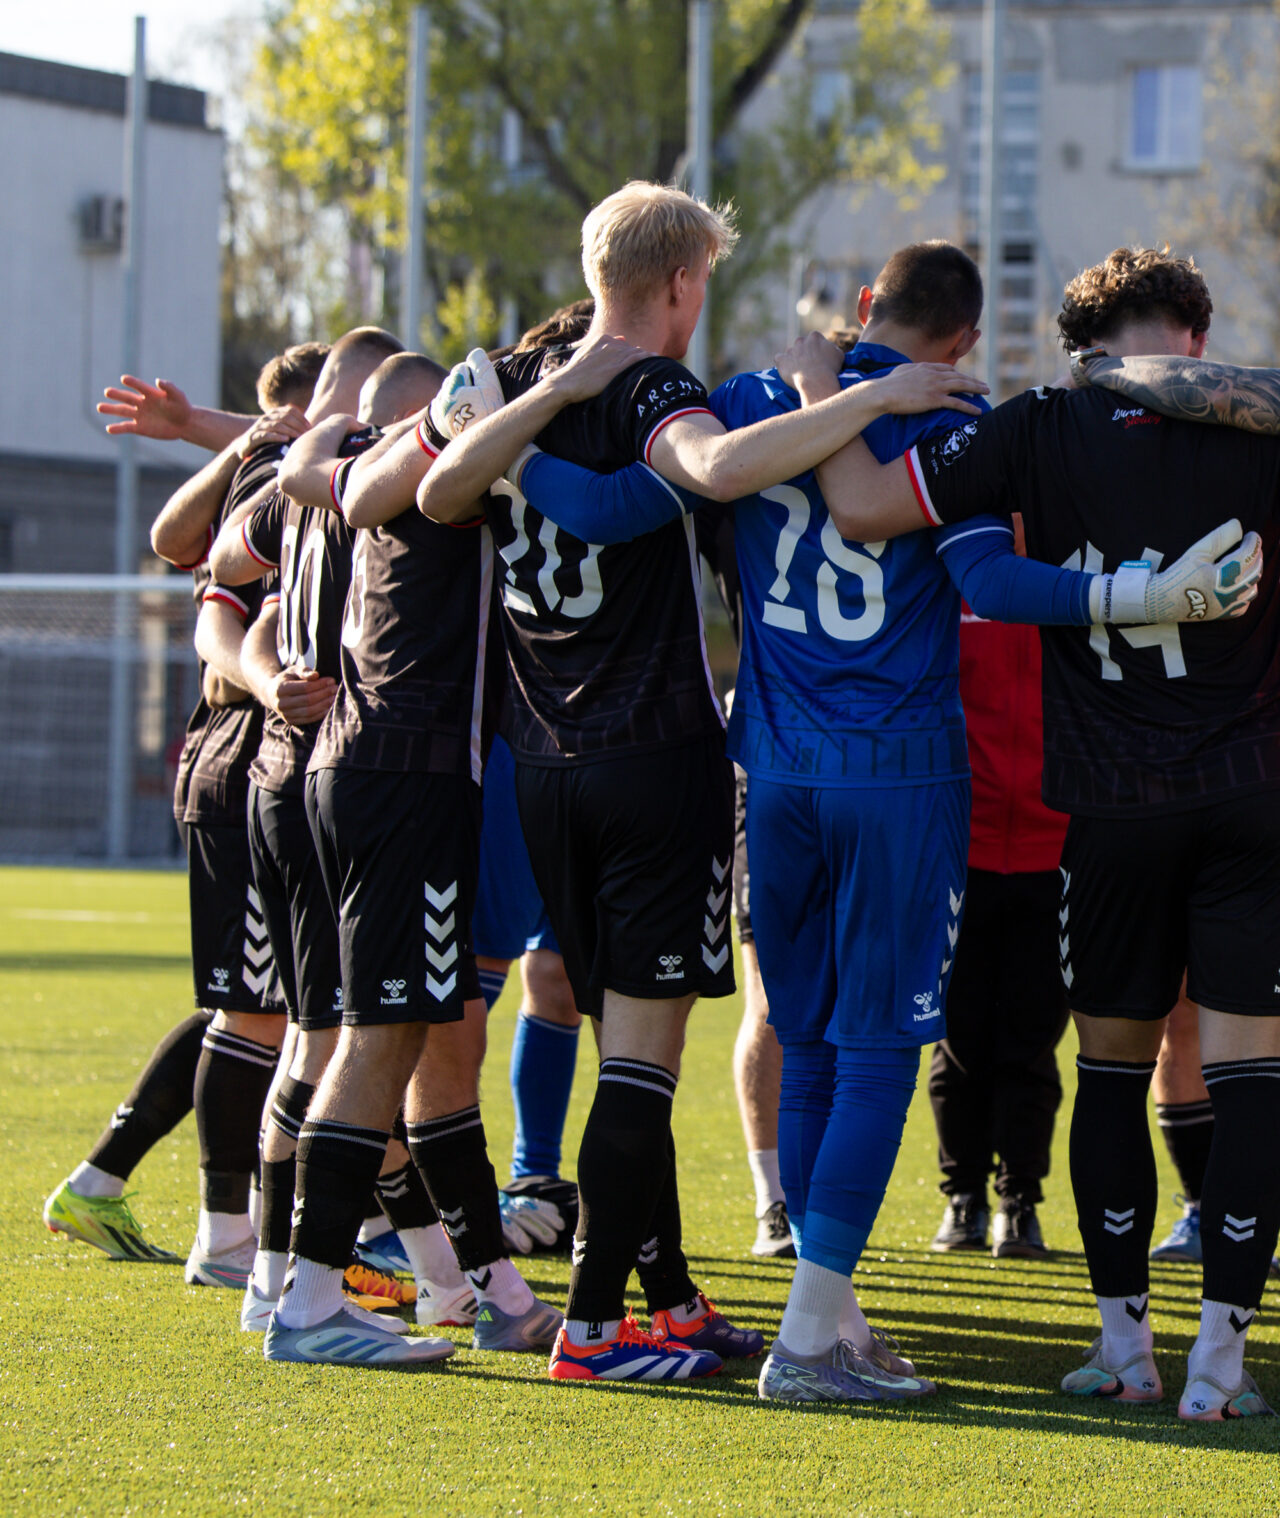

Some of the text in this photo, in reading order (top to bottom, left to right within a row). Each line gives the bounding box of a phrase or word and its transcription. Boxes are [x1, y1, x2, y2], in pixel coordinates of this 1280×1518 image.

[490, 477, 604, 619] 20
[759, 484, 886, 642] 28
[380, 995, 408, 1005] hummel
[655, 970, 685, 981] hummel
